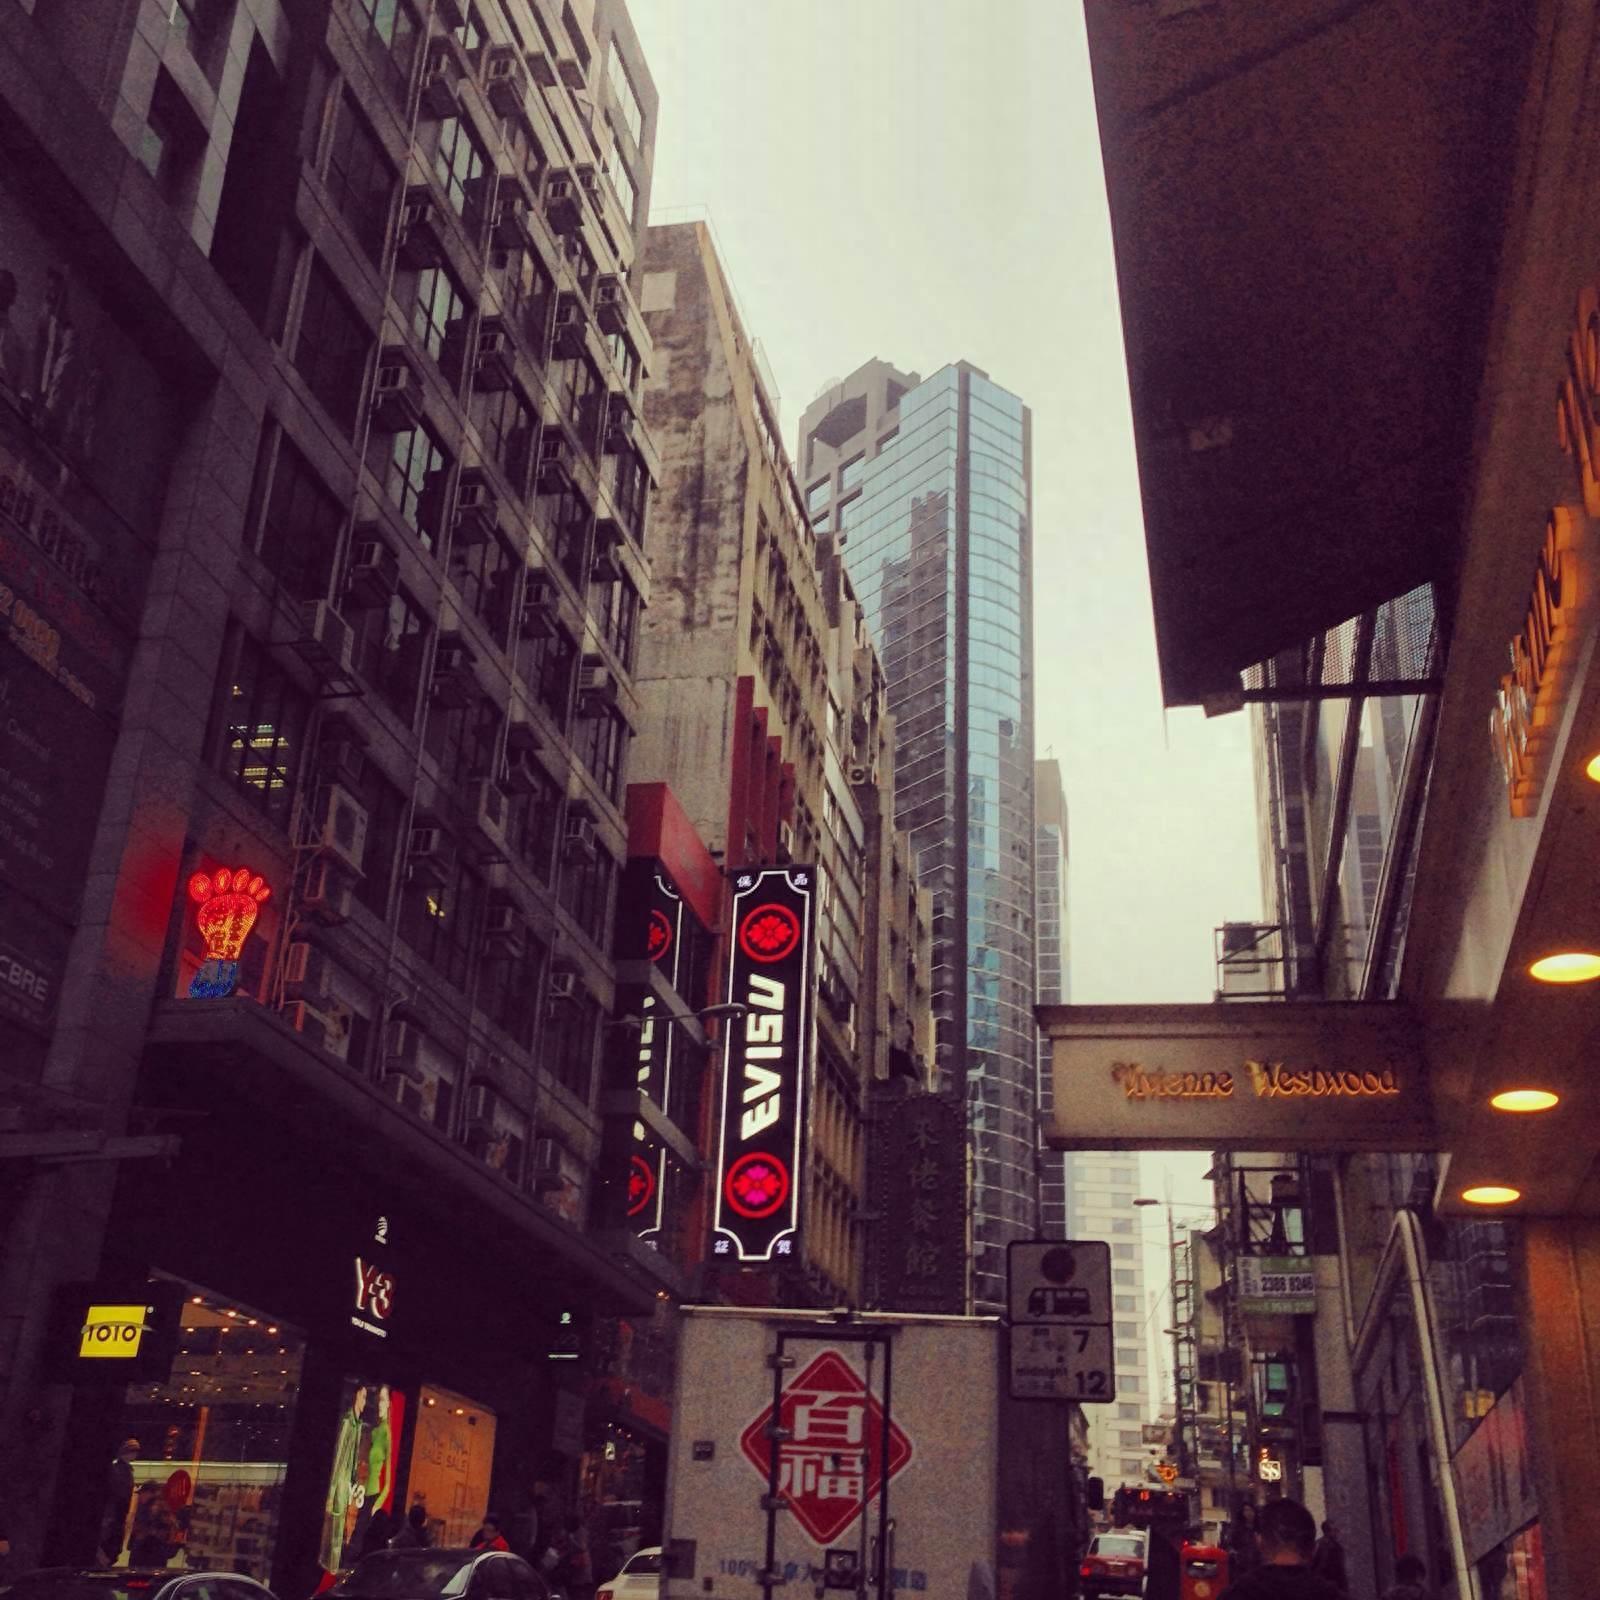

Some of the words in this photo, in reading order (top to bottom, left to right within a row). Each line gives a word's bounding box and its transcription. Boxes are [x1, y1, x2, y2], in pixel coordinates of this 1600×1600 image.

[740, 973, 785, 1141] EVISU
[1111, 1060, 1234, 1098] Vivienne
[1244, 1058, 1400, 1098] Westwood
[1073, 1329, 1090, 1353] 7
[1075, 1369, 1106, 1395] 12
